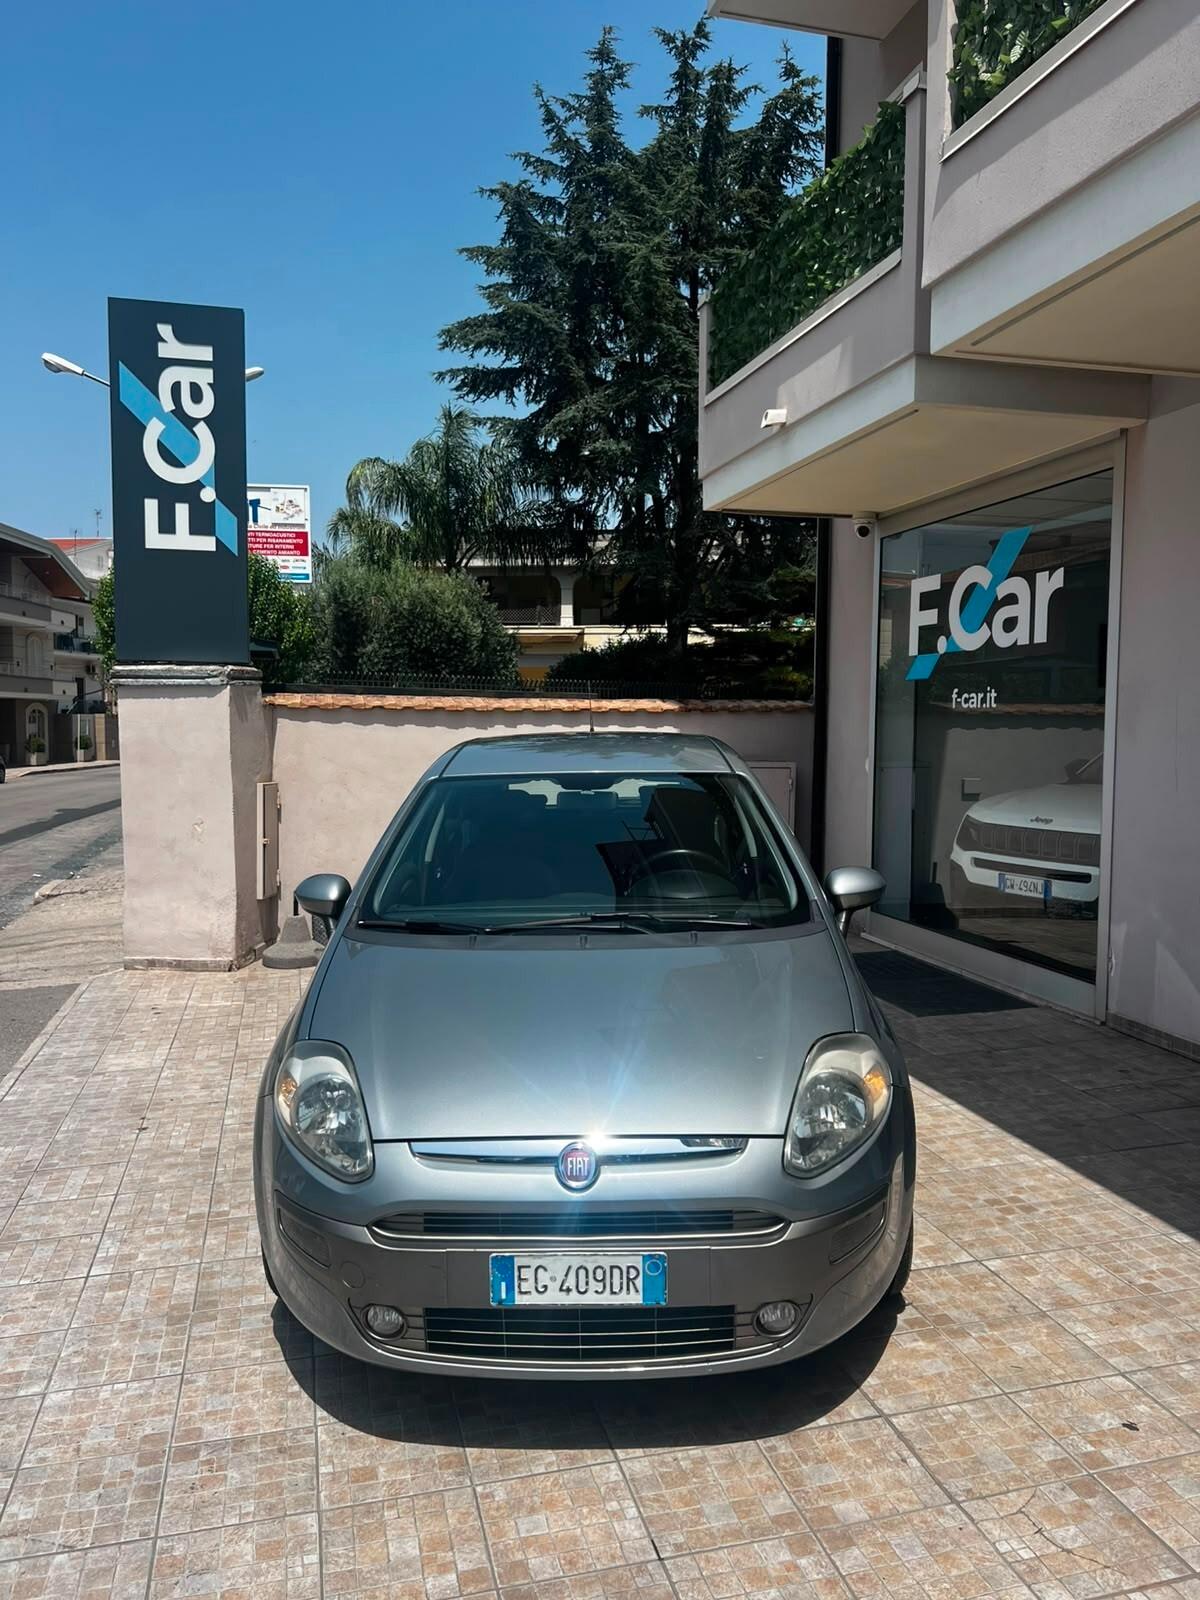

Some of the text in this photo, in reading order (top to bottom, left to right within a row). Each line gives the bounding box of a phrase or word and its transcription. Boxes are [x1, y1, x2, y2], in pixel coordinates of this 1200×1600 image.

[143, 322, 217, 551] F.Car
[908, 565, 1065, 657] F.Car
[951, 687, 998, 709] f-car.it
[567, 1157, 589, 1177] FIAT
